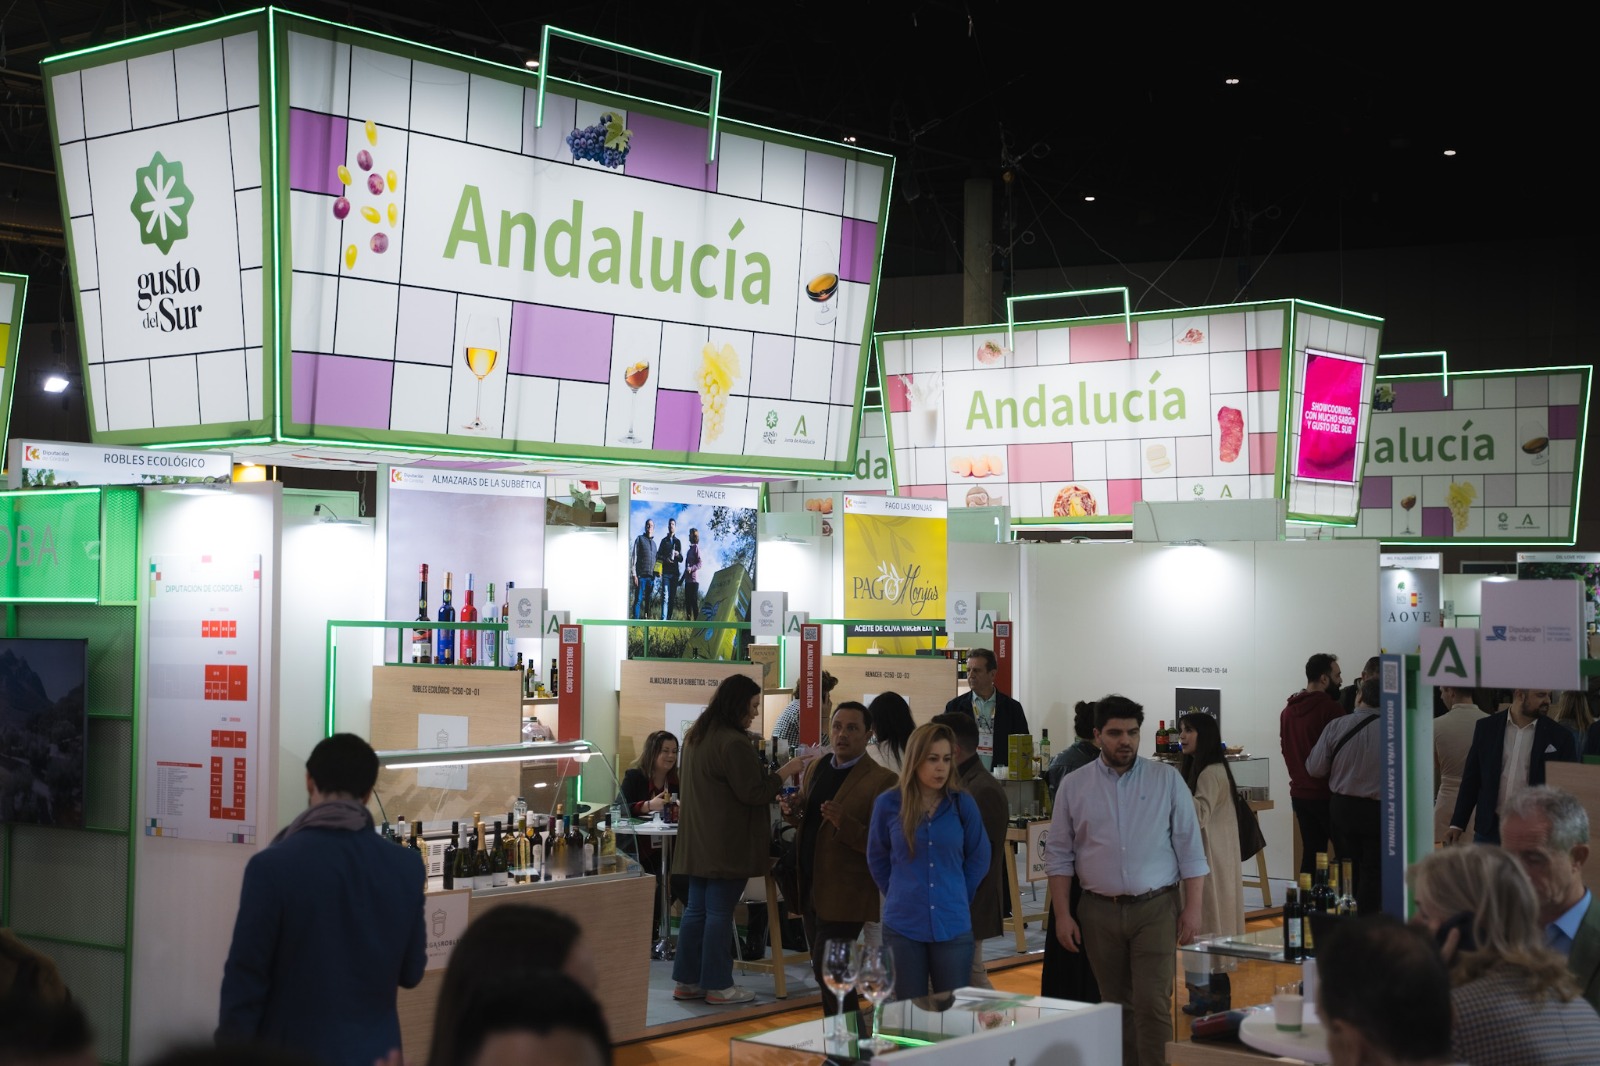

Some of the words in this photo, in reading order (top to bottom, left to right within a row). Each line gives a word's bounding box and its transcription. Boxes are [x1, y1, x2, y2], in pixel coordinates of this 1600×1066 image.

[442, 184, 771, 305] Andalucía
[137, 260, 200, 311] gusto
[143, 312, 158, 329] del
[159, 297, 202, 332] Sur
[966, 369, 1186, 430] Andalucía
[1305, 411, 1317, 420] CON
[1318, 412, 1337, 423] MUCHO
[1338, 415, 1356, 426] SABOR
[1307, 421, 1312, 429] Y
[1312, 421, 1330, 432] GUSTO
[1331, 424, 1340, 433] DEL
[1341, 425, 1353, 434] SUR
[1366, 419, 1495, 464] alucía
[104, 453, 144, 466] ROBLES
[147, 455, 205, 468] ECOLÓGICO
[432, 474, 477, 486] ALMAZARAS
[479, 478, 488, 487] DE
[490, 478, 500, 487] LA
[501, 479, 541, 489] SUBBÉTICA
[697, 490, 726, 499] RENACER
[885, 502, 900, 510] PAGO
[911, 503, 932, 511] MONJAS
[412, 685, 428, 693] ROBLES
[673, 677, 678, 685] DE
[1387, 700, 1395, 739] BODEGA
[1387, 742, 1396, 765] VIÑA
[1387, 767, 1395, 799] SANTA
[1388, 802, 1396, 856] PETRONILA
